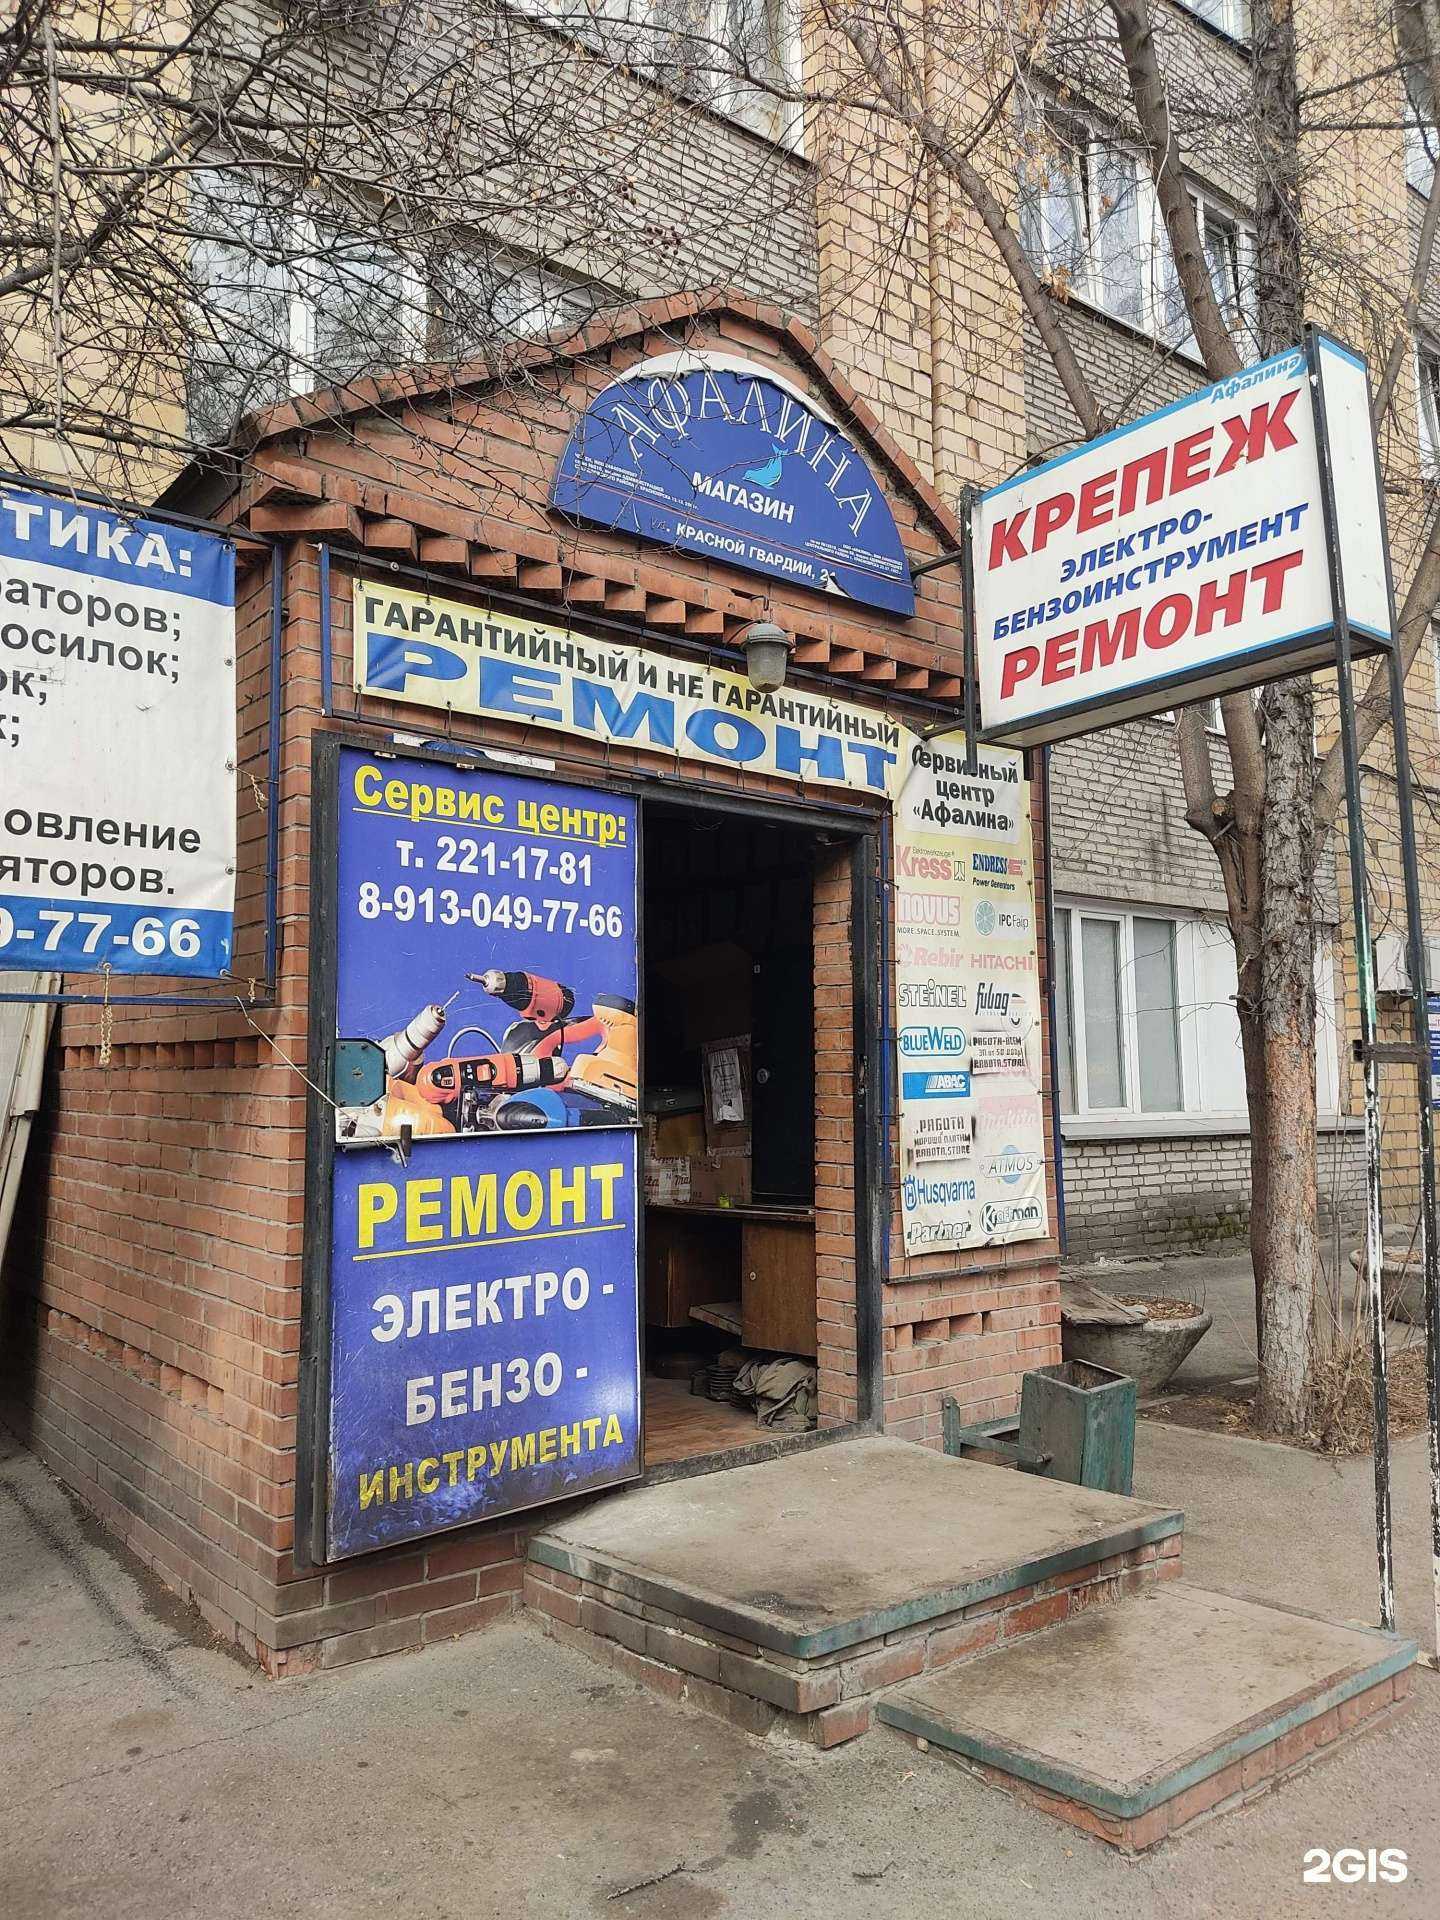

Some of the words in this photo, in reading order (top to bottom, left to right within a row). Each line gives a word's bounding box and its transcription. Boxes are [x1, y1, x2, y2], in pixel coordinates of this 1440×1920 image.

[1211, 354, 1301, 404] Афалина
[611, 372, 872, 537] АФАЛИНА
[987, 388, 1302, 571] КРЕПЕЖ
[692, 471, 795, 524] МАГАЗИН
[2, 498, 192, 578] ТИКА:
[676, 522, 746, 556] КРАСНОЙ
[750, 546, 815, 580] ГВАРДИИ,
[1059, 507, 1213, 582] ЭЛЕКТРО-
[993, 502, 1309, 641] БЕНЗОИНСТРУМЕНТ
[0, 578, 181, 642] аторов;
[999, 550, 1304, 700] РЕМОНТ
[1, 623, 180, 684] осилок;
[365, 597, 629, 682] ГАРАНТИЙНЫЙ
[638, 656, 658, 682] И
[667, 669, 704, 699] НЕ
[712, 679, 901, 749] ГАРАНТИЙНЫЙ
[366, 631, 898, 791] РЕМОНТ
[912, 744, 1019, 783] Сервиный
[354, 764, 505, 824] Сервис
[517, 799, 628, 848] центр:
[913, 799, 1015, 831] «Афалина»
[936, 780, 995, 807] центр
[4, 808, 201, 853] овление
[0, 855, 175, 897] яторов.
[396, 839, 424, 869] т.
[436, 835, 592, 887] 221-17-81
[895, 845, 952, 880] Kress
[972, 853, 1008, 875] ENDRESS
[972, 877, 990, 888] Power
[358, 881, 624, 939] 8-913-049-77-66
[970, 953, 1033, 970] HITACHI
[975, 982, 1009, 1016] fubag
[917, 1179, 976, 1206] Husqvarna
[989, 1156, 1033, 1174] ATMOS
[358, 1163, 624, 1249] РЕМОНТ
[908, 1221, 971, 1245] Partner
[370, 1266, 590, 1343] ЭЛЕКТРО
[405, 1351, 563, 1426] БЕНЗО
[358, 1413, 624, 1511] ИНСТРУМЕНТА
